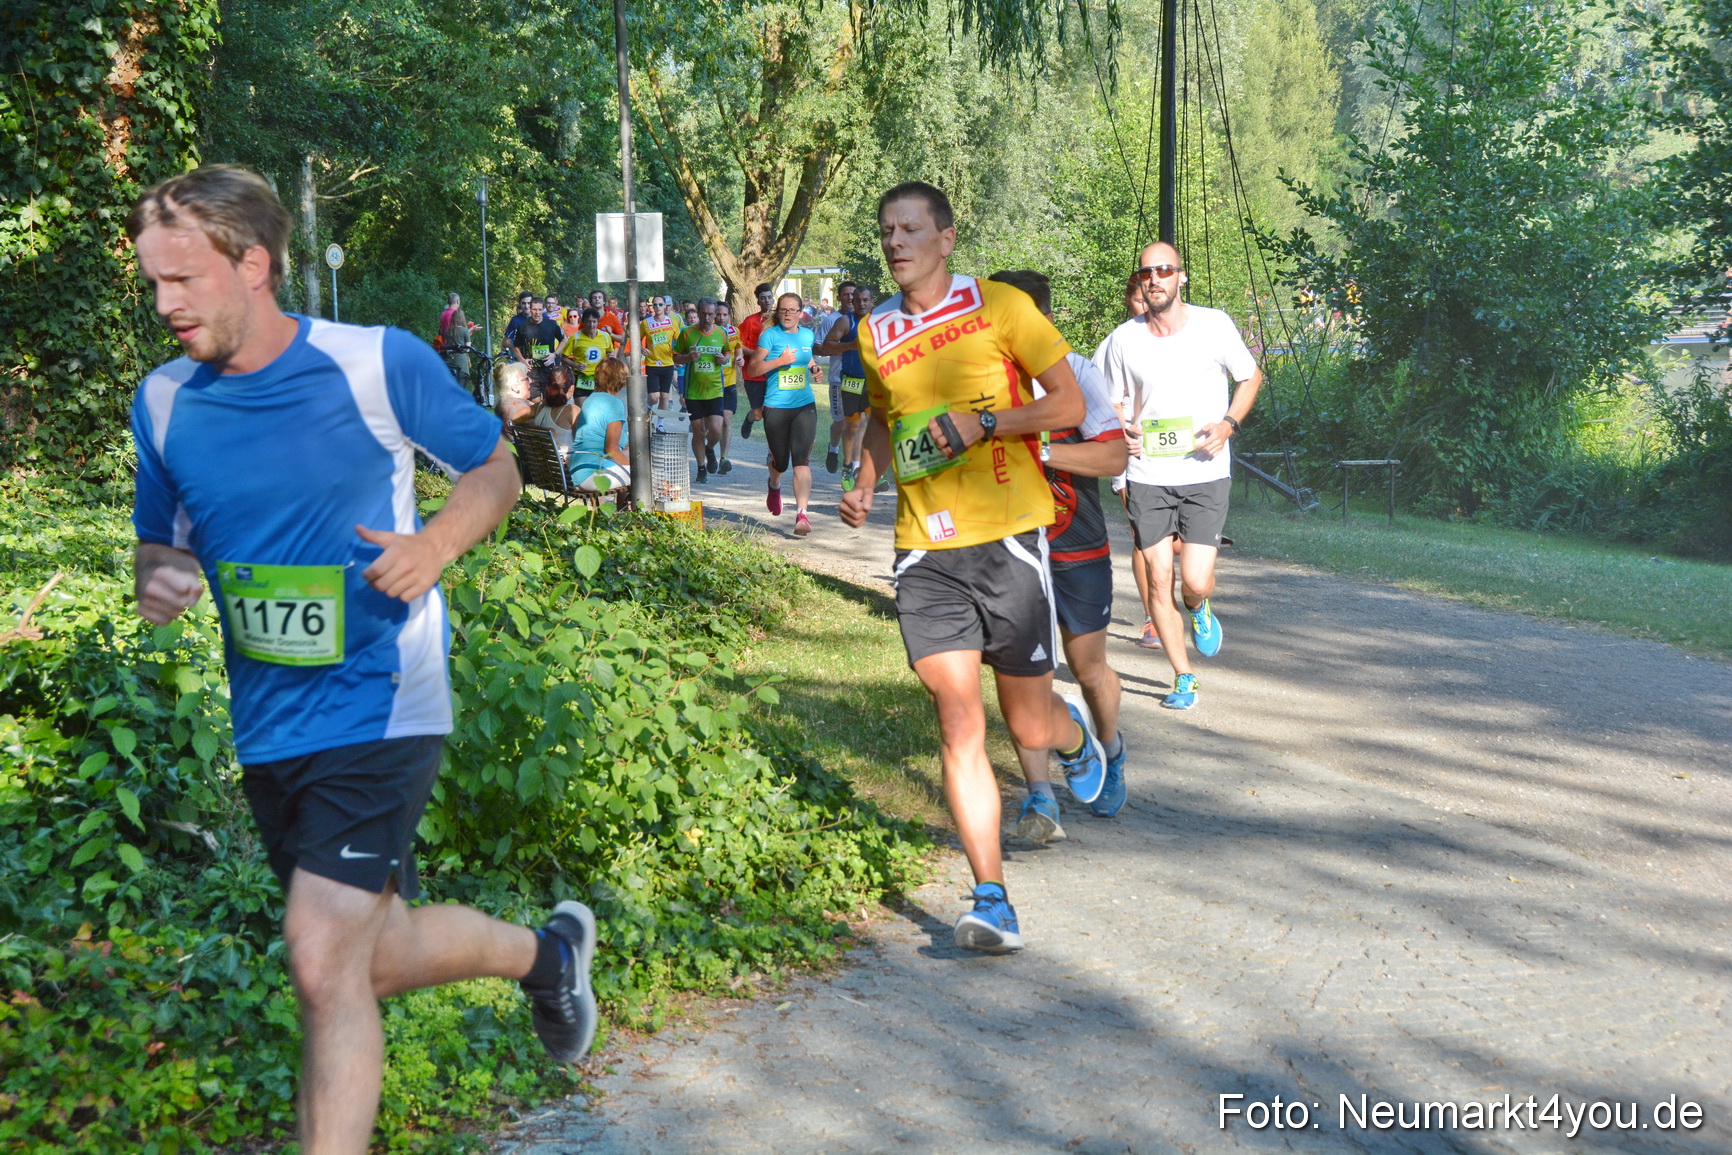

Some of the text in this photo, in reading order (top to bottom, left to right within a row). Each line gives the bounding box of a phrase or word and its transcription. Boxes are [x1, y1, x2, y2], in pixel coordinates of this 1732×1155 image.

[878, 315, 992, 380] MAX BÖGL
[588, 350, 598, 360] B
[580, 379, 592, 387] 241
[782, 374, 804, 384] 1526
[843, 379, 860, 389] 1181
[1159, 431, 1177, 446] 58
[234, 598, 325, 636] 1176
